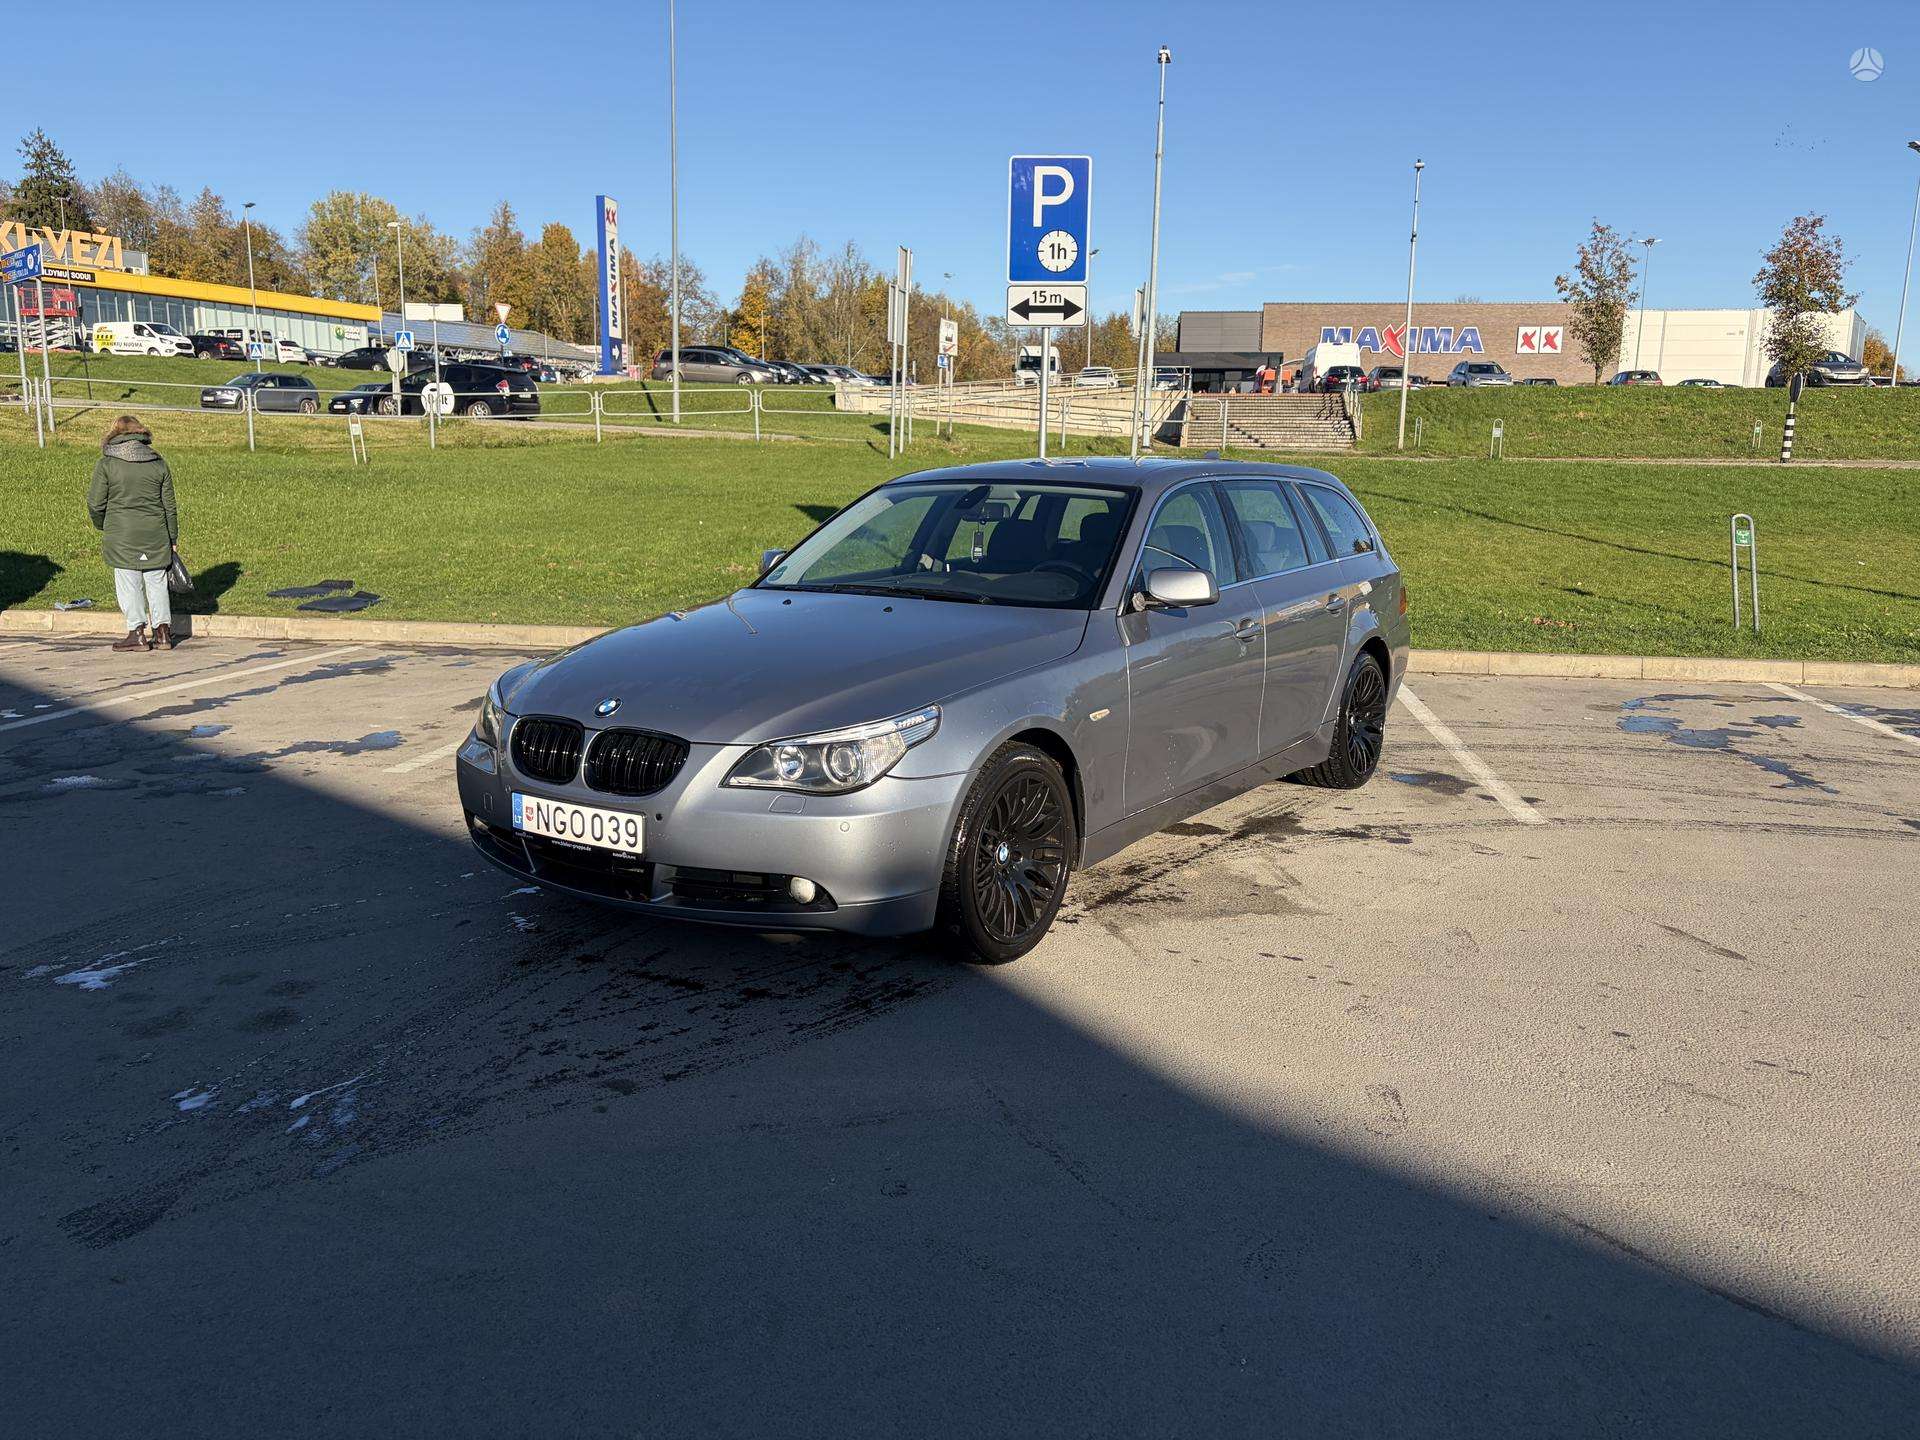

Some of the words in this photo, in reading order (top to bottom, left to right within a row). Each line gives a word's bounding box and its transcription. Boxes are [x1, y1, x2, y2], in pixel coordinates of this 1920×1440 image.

[1032, 165, 1075, 228] P
[605, 207, 617, 226] XX
[42, 226, 123, 269] VEŽI
[1048, 243, 1067, 260] 1h
[609, 237, 618, 329] MAXIMA
[1032, 290, 1047, 304] 15
[1049, 293, 1062, 304] m
[1320, 322, 1484, 358] MAXIMA
